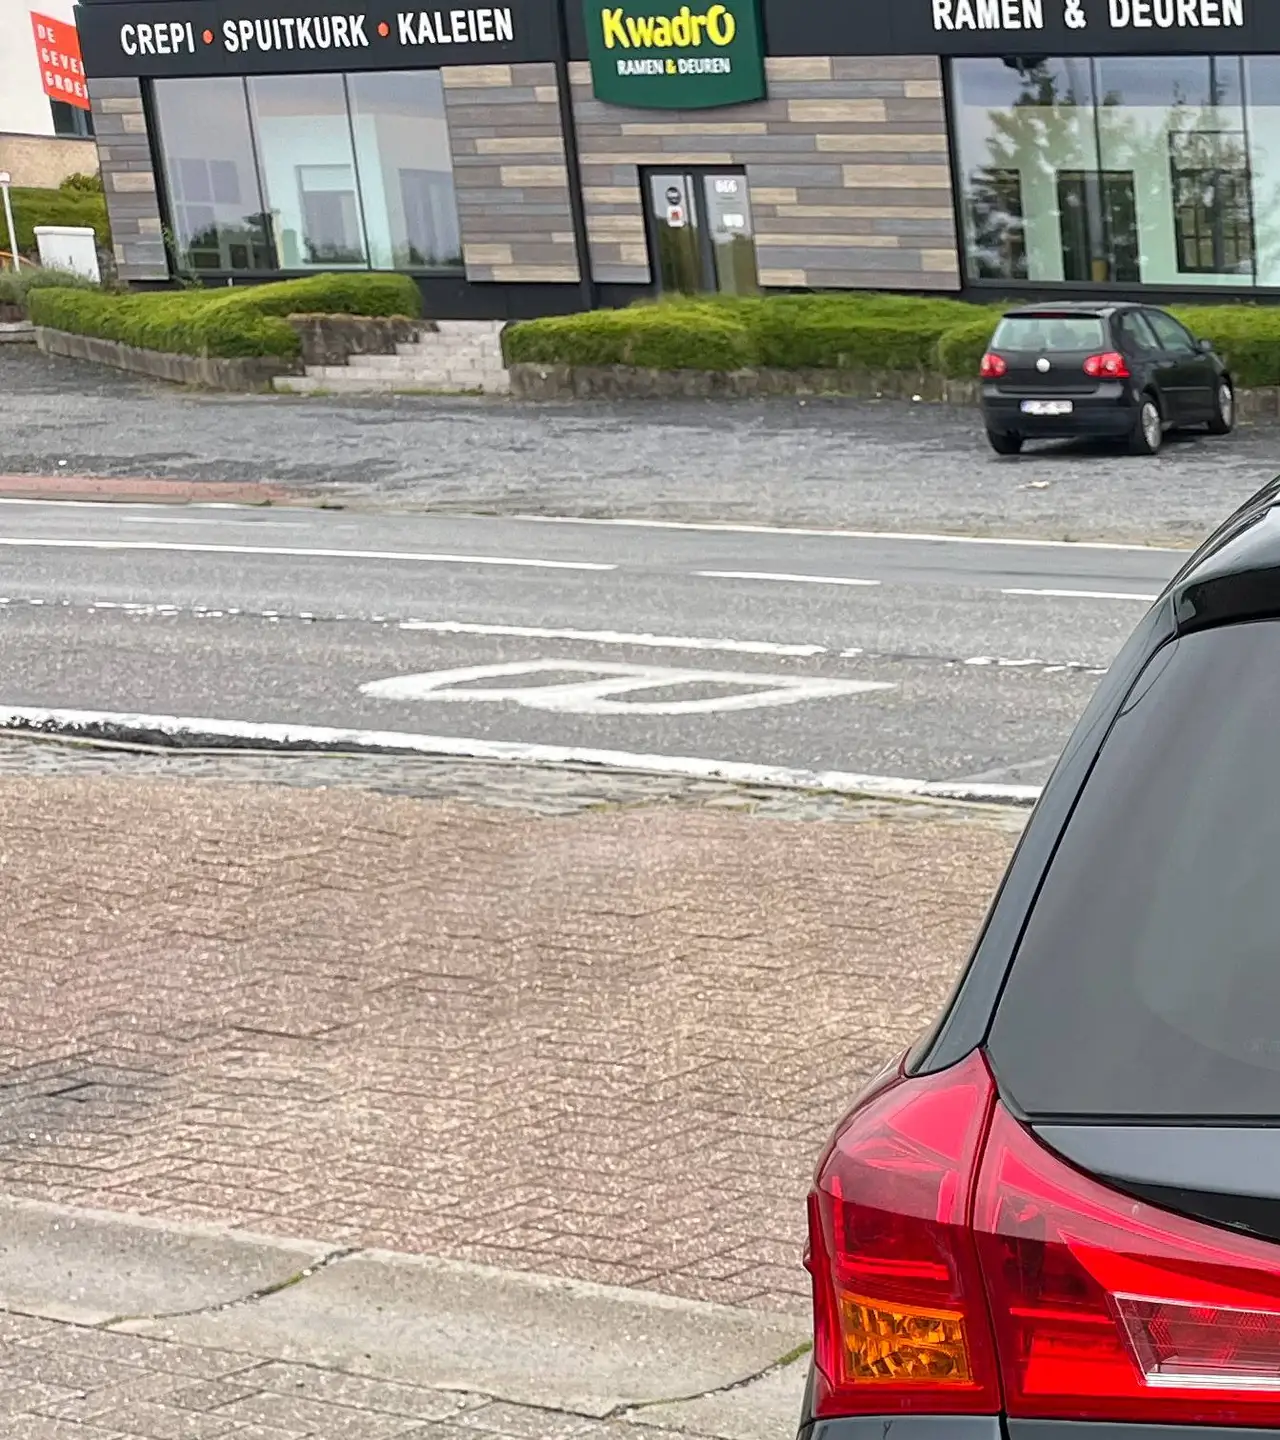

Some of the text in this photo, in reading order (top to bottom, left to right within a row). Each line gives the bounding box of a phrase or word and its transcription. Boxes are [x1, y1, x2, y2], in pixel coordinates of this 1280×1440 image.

[932, 0, 1244, 30] RAMEN & DEUREN
[37, 23, 56, 43] DE
[120, 8, 513, 55] CREPI SPUITKURK KALEIEN
[617, 57, 731, 75] RAMEN & DEUREN
